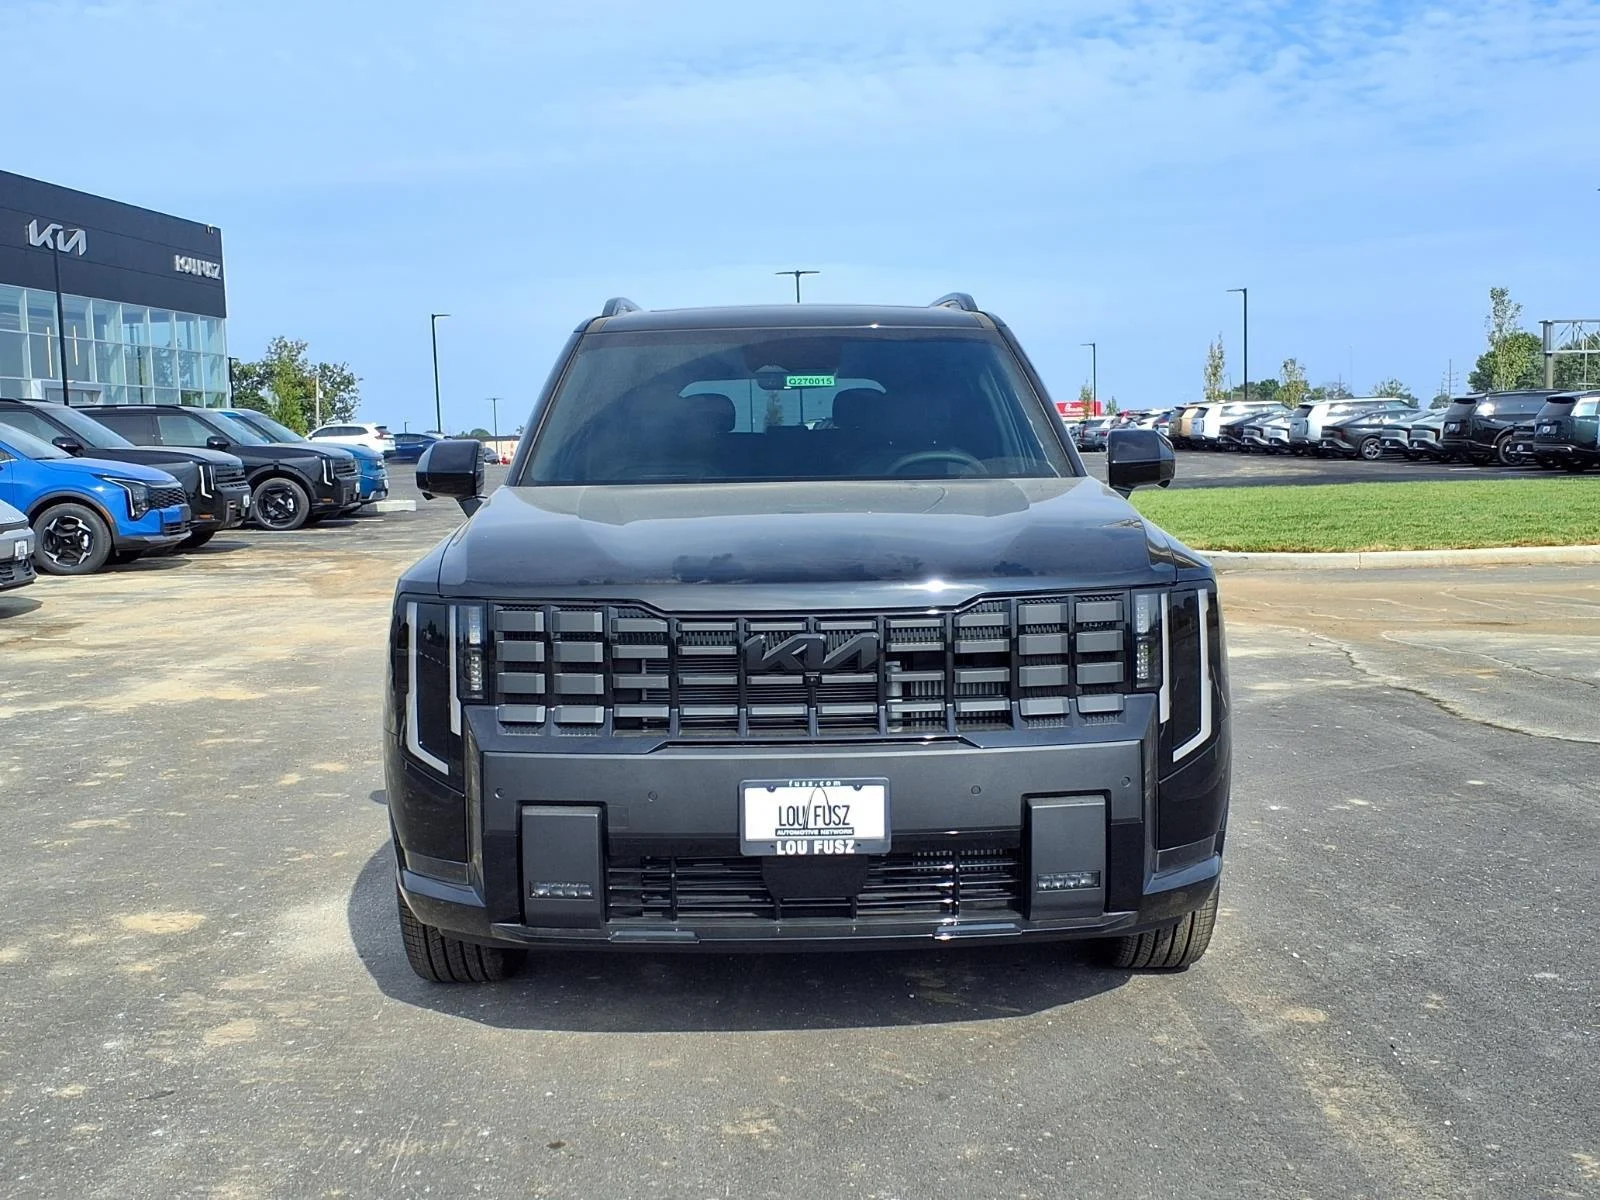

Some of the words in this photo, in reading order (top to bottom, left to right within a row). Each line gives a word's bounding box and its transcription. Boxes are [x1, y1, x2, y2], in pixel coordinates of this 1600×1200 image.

[28, 219, 87, 256] KIA
[788, 377, 832, 385] Q270015
[742, 632, 879, 672] KIA
[779, 805, 806, 826] LOU
[814, 805, 850, 826] FUSZ
[776, 840, 808, 855] LOU
[813, 840, 855, 855] FUSZ
